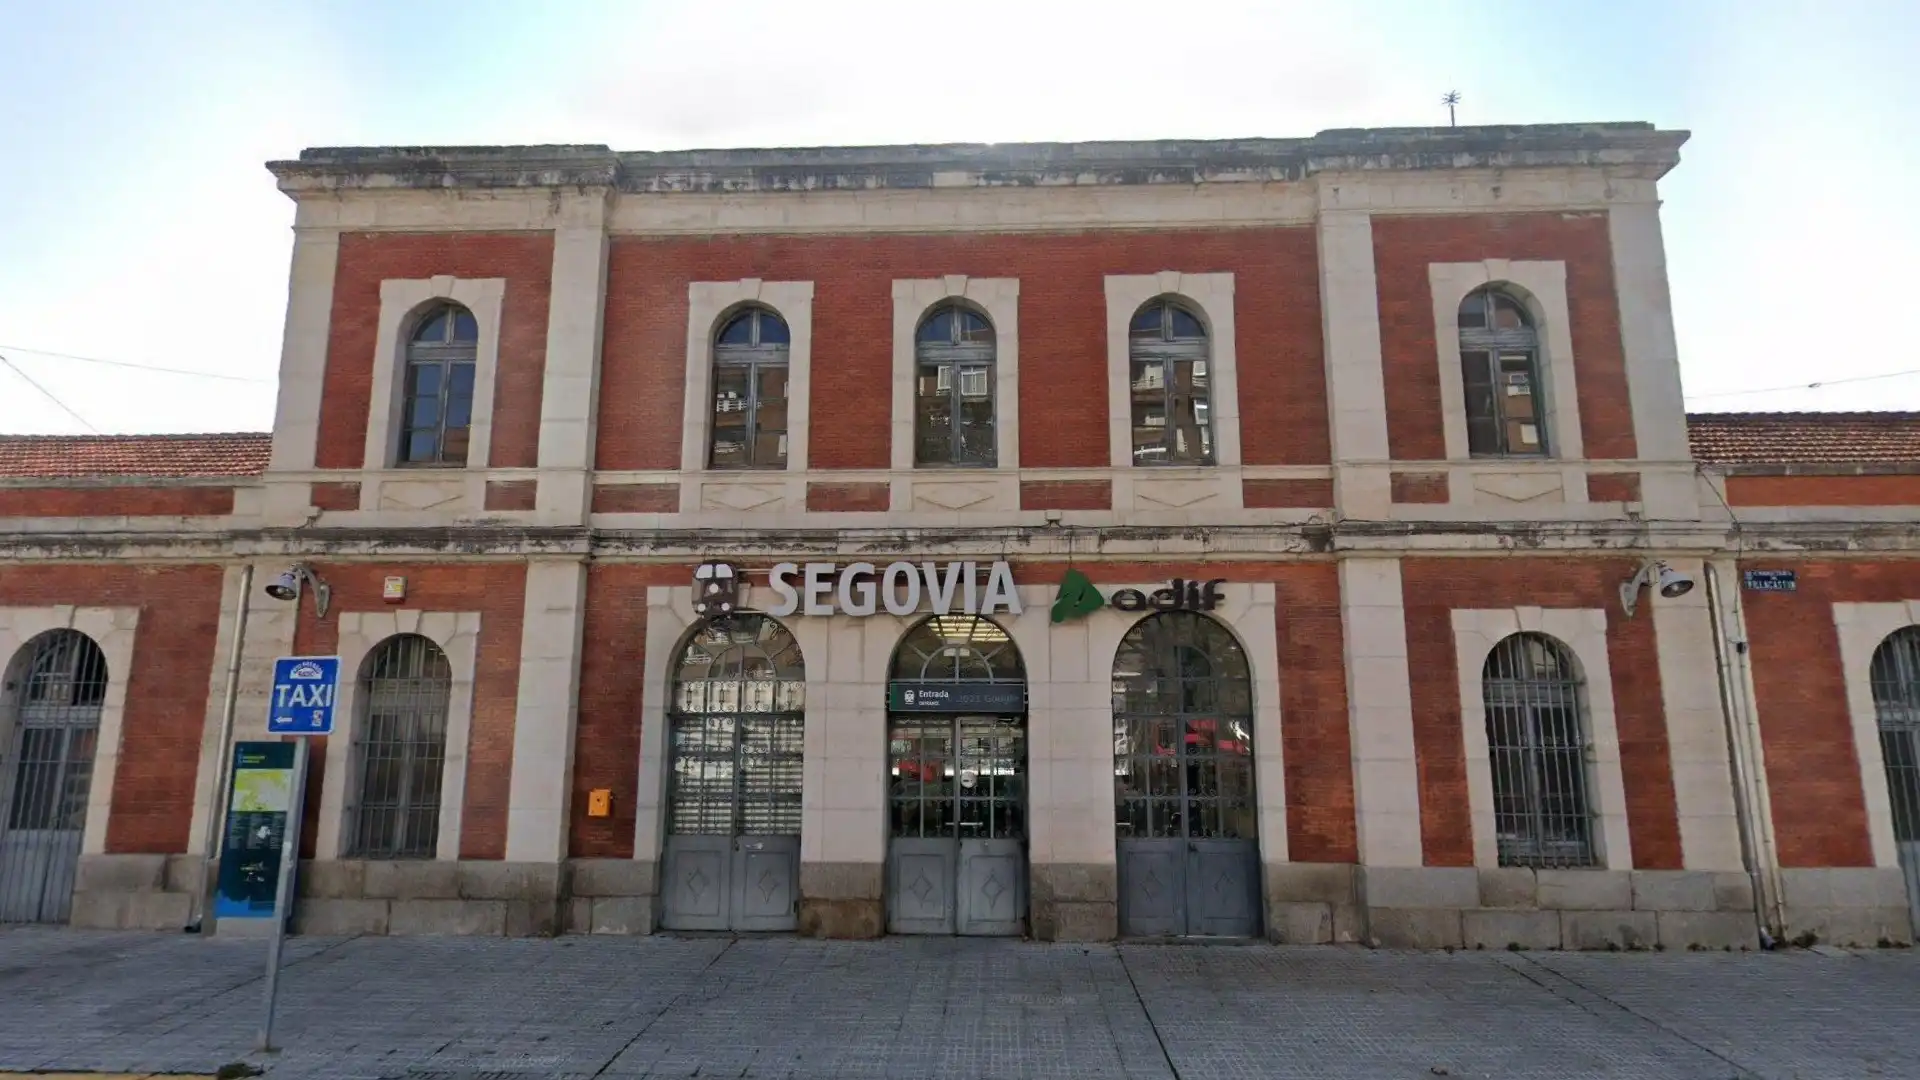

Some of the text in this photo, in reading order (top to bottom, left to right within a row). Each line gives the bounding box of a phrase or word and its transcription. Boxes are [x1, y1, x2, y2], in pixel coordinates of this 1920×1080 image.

[768, 561, 1022, 617] SEGOVIA
[1111, 578, 1227, 611] adif
[275, 684, 333, 708] TAXI
[919, 690, 949, 698] Entrada
